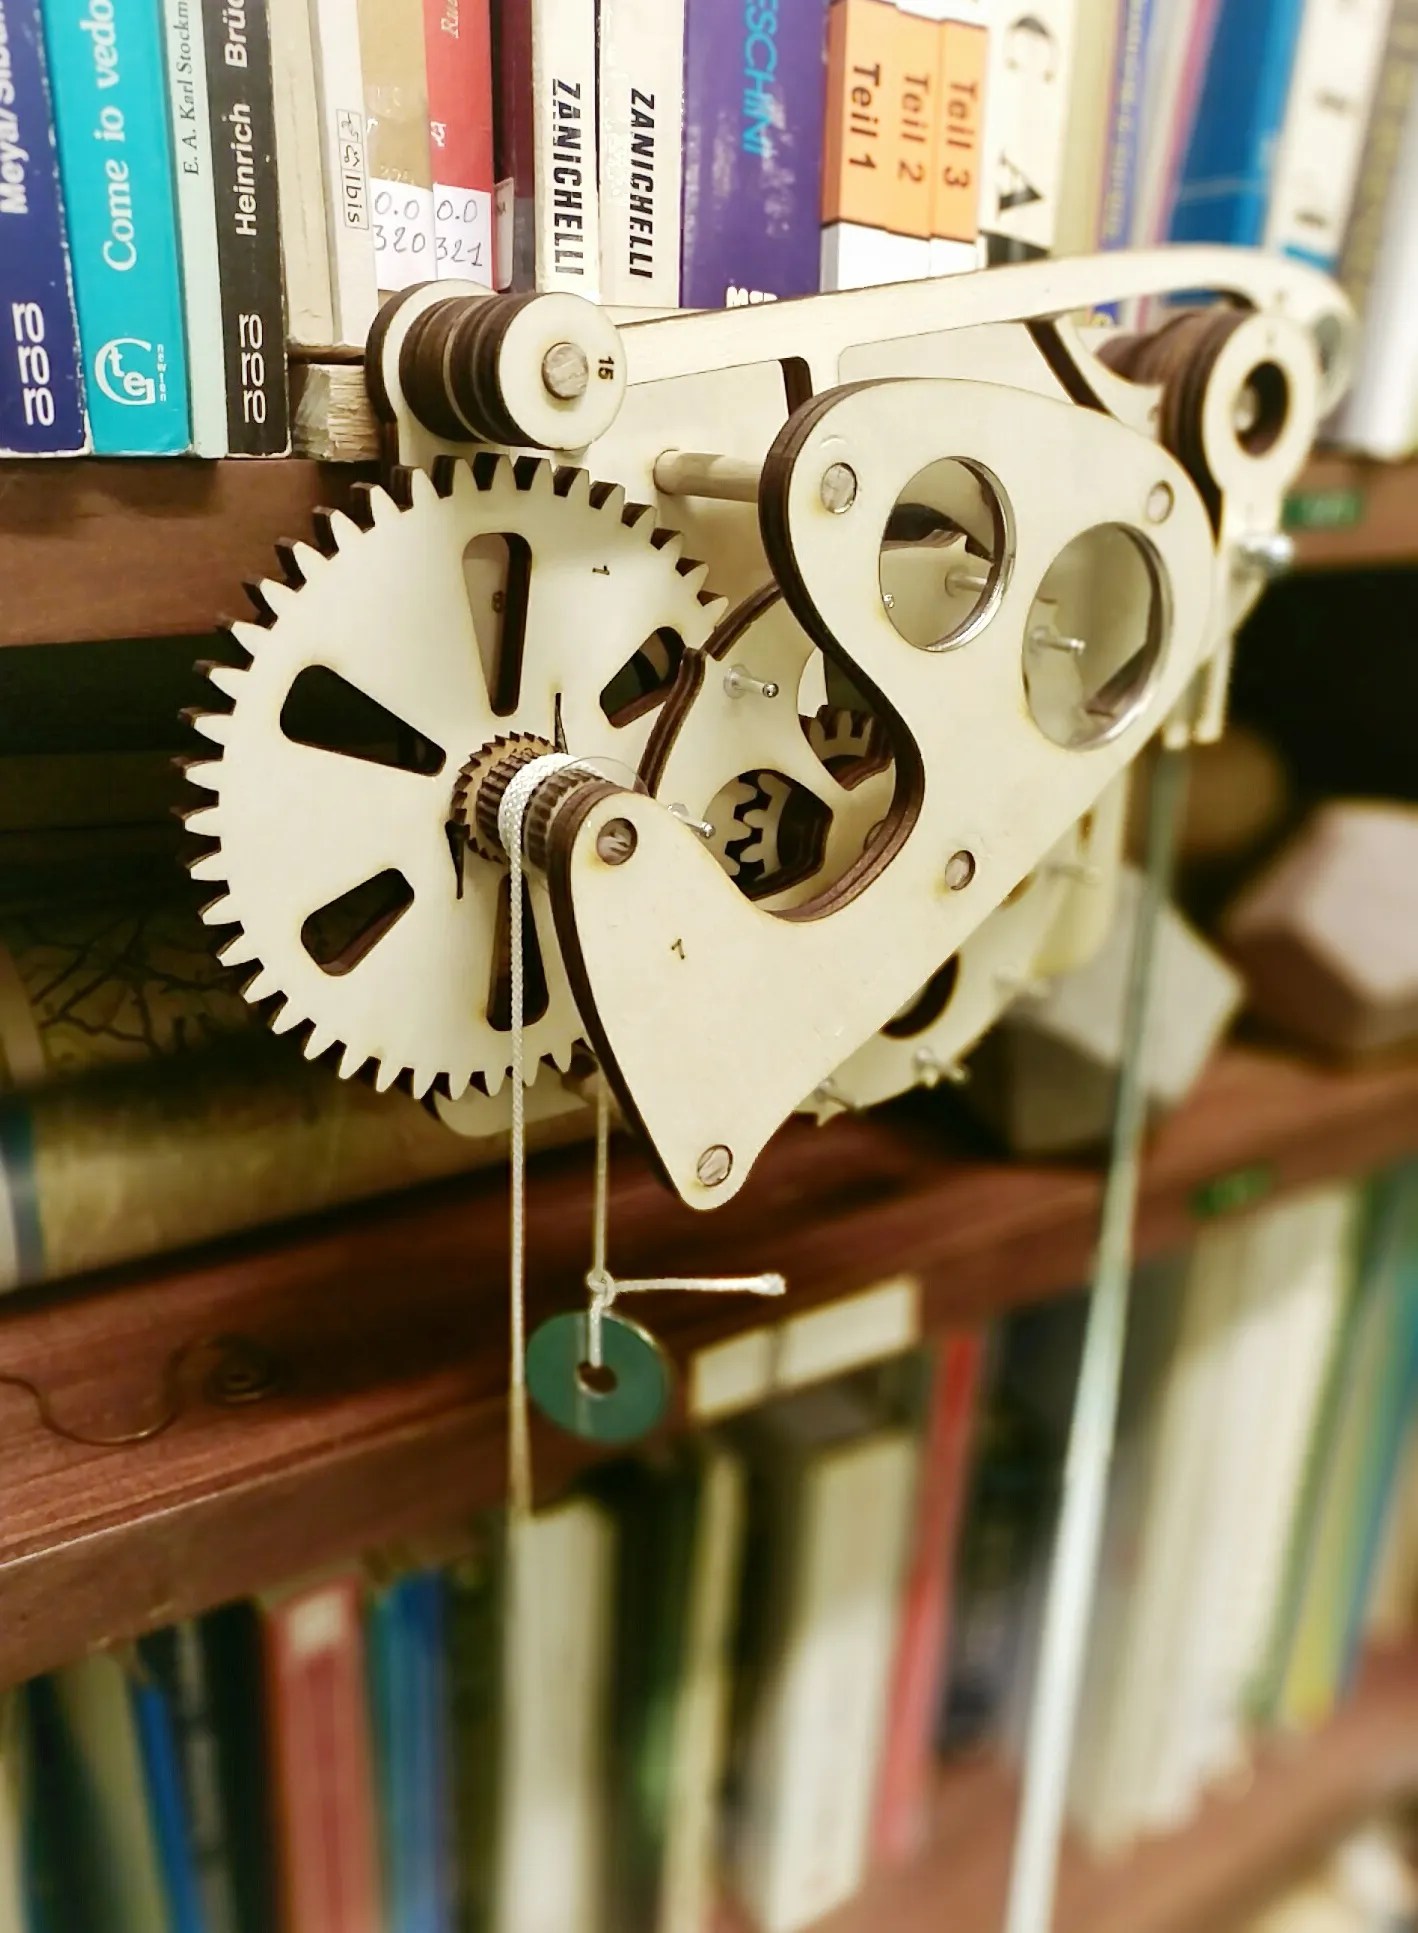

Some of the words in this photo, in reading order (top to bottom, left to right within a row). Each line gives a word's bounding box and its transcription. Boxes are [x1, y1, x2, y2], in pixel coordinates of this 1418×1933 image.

[176, 79, 196, 121] Karl
[850, 63, 881, 139] Teil
[901, 73, 929, 144] Teil
[946, 80, 978, 149] Teil
[92, 105, 126, 143] io
[182, 128, 198, 151] A.
[184, 155, 199, 176] E.
[221, 102, 257, 237] Heinrich
[552, 78, 584, 277] ZANICHELLI
[848, 153, 877, 170] 1
[898, 159, 926, 184] 2
[943, 165, 971, 189] 3
[628, 87, 655, 279] ZANICHELLI
[102, 158, 138, 272] Come
[375, 191, 420, 221] 0.0
[436, 199, 478, 223] 0.0
[372, 224, 427, 253] 320
[435, 236, 483, 267] 321
